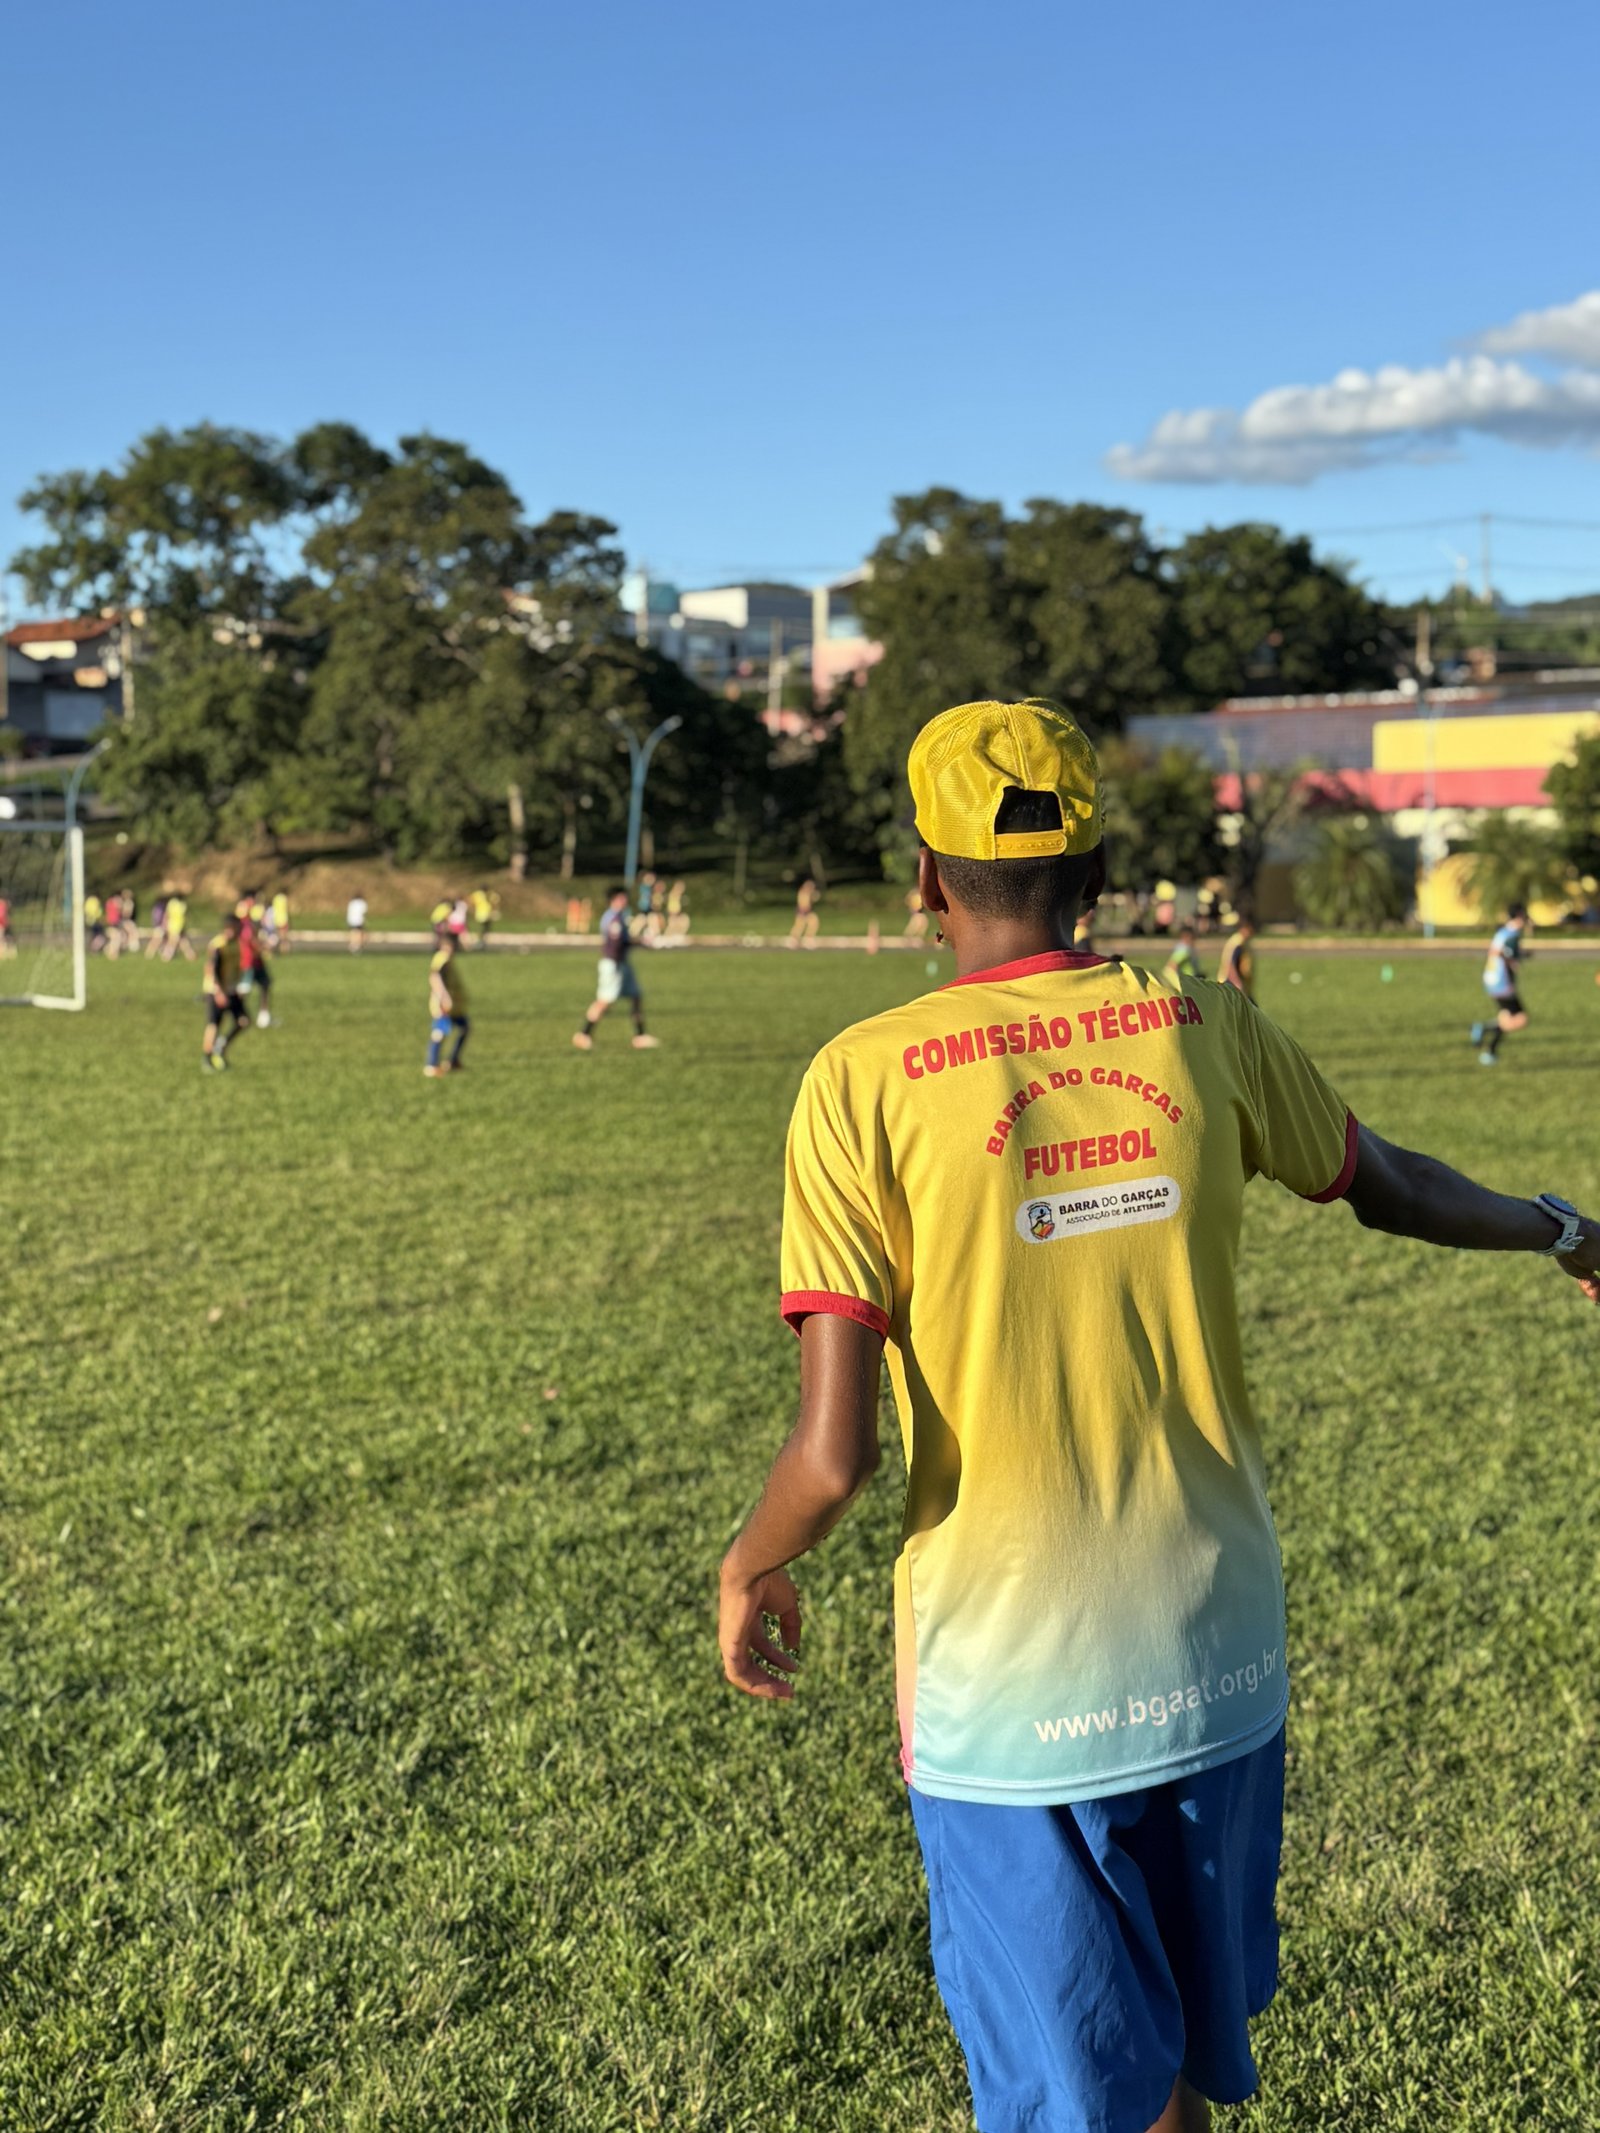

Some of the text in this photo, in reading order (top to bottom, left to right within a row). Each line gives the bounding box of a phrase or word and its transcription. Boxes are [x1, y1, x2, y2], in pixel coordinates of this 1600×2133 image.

[903, 996, 1204, 1079] COMISSÃO TÉCNICA
[986, 1067, 1184, 1157] BARRA DO GARÇAS
[1023, 1127, 1158, 1180] FUTEBOL
[1058, 1187, 1170, 1215] BARRA DO GARÇAS
[1112, 1208, 1121, 1216] DE
[1034, 1648, 1278, 1742] www.bgaat.org.br
